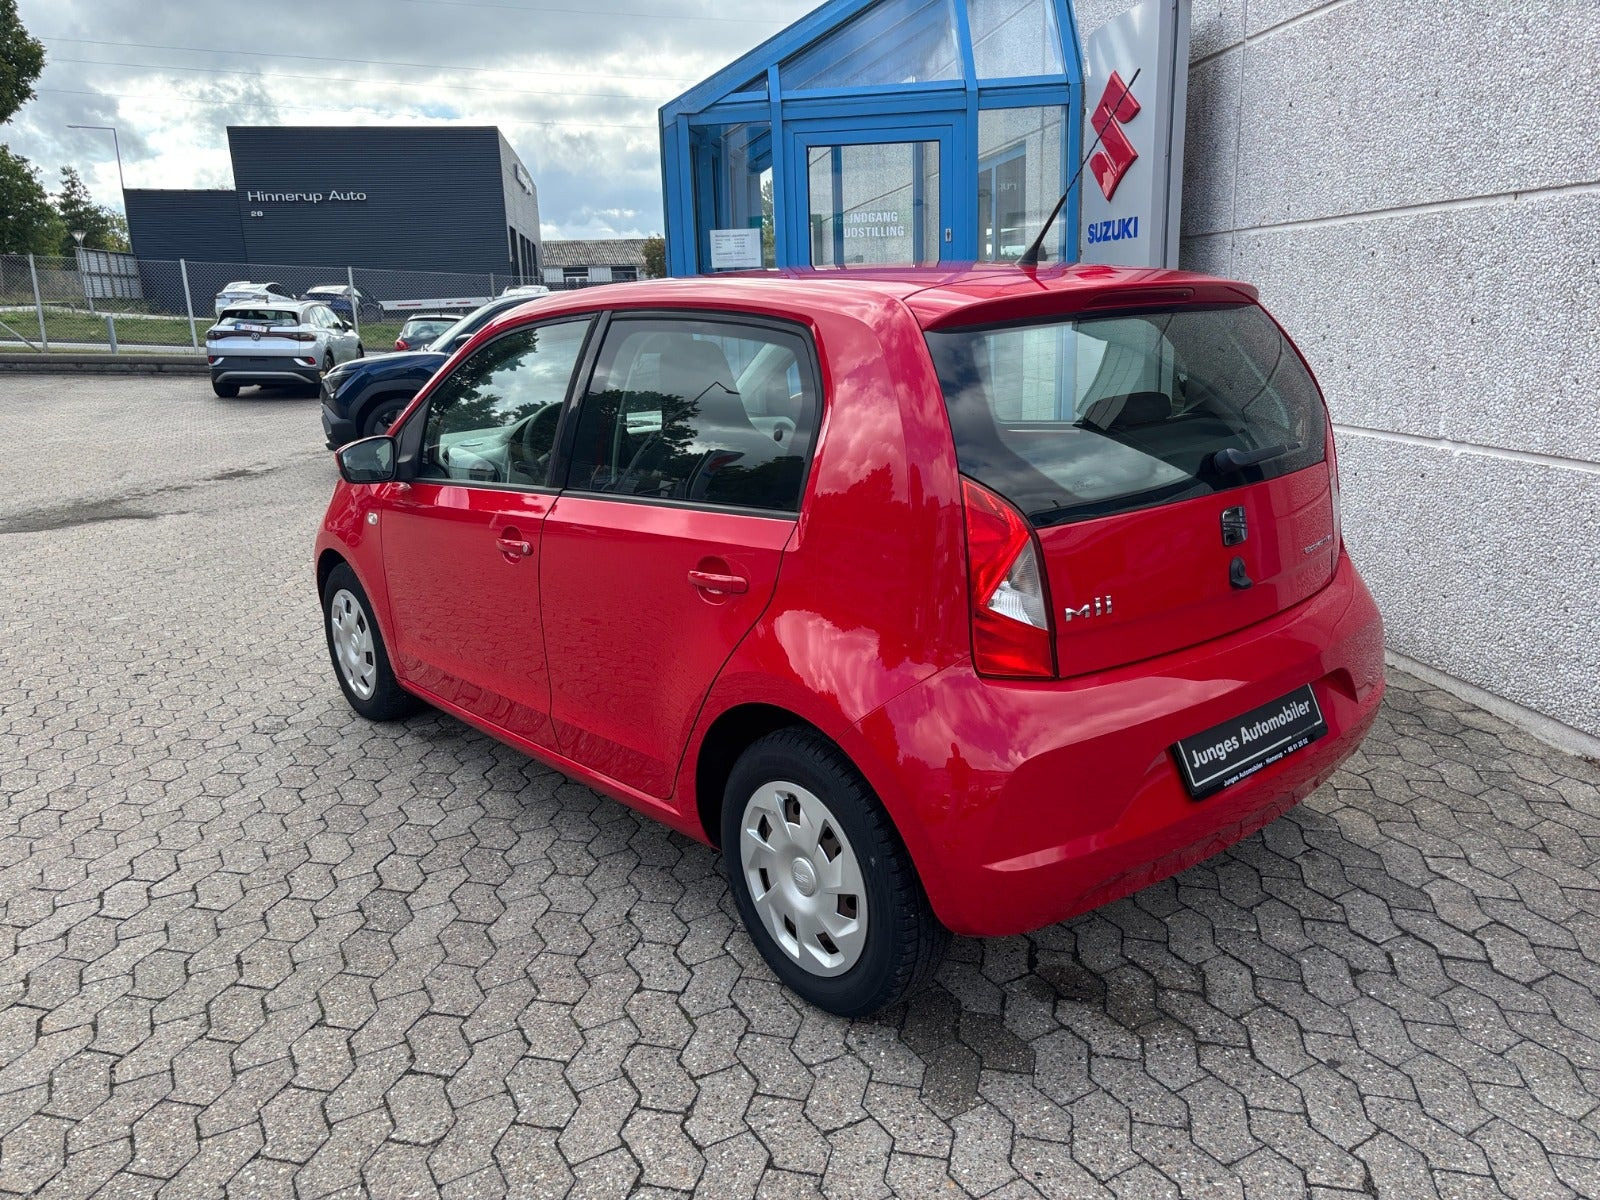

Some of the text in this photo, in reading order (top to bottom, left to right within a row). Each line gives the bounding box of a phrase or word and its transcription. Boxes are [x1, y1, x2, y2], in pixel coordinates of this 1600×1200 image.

[247, 190, 367, 204] Hinnerup Auto
[849, 211, 898, 224] INDGANG
[843, 225, 905, 238] UDSTILLING
[1087, 216, 1139, 244] SUZUKI
[1191, 700, 1310, 768] Junges Automobiler
